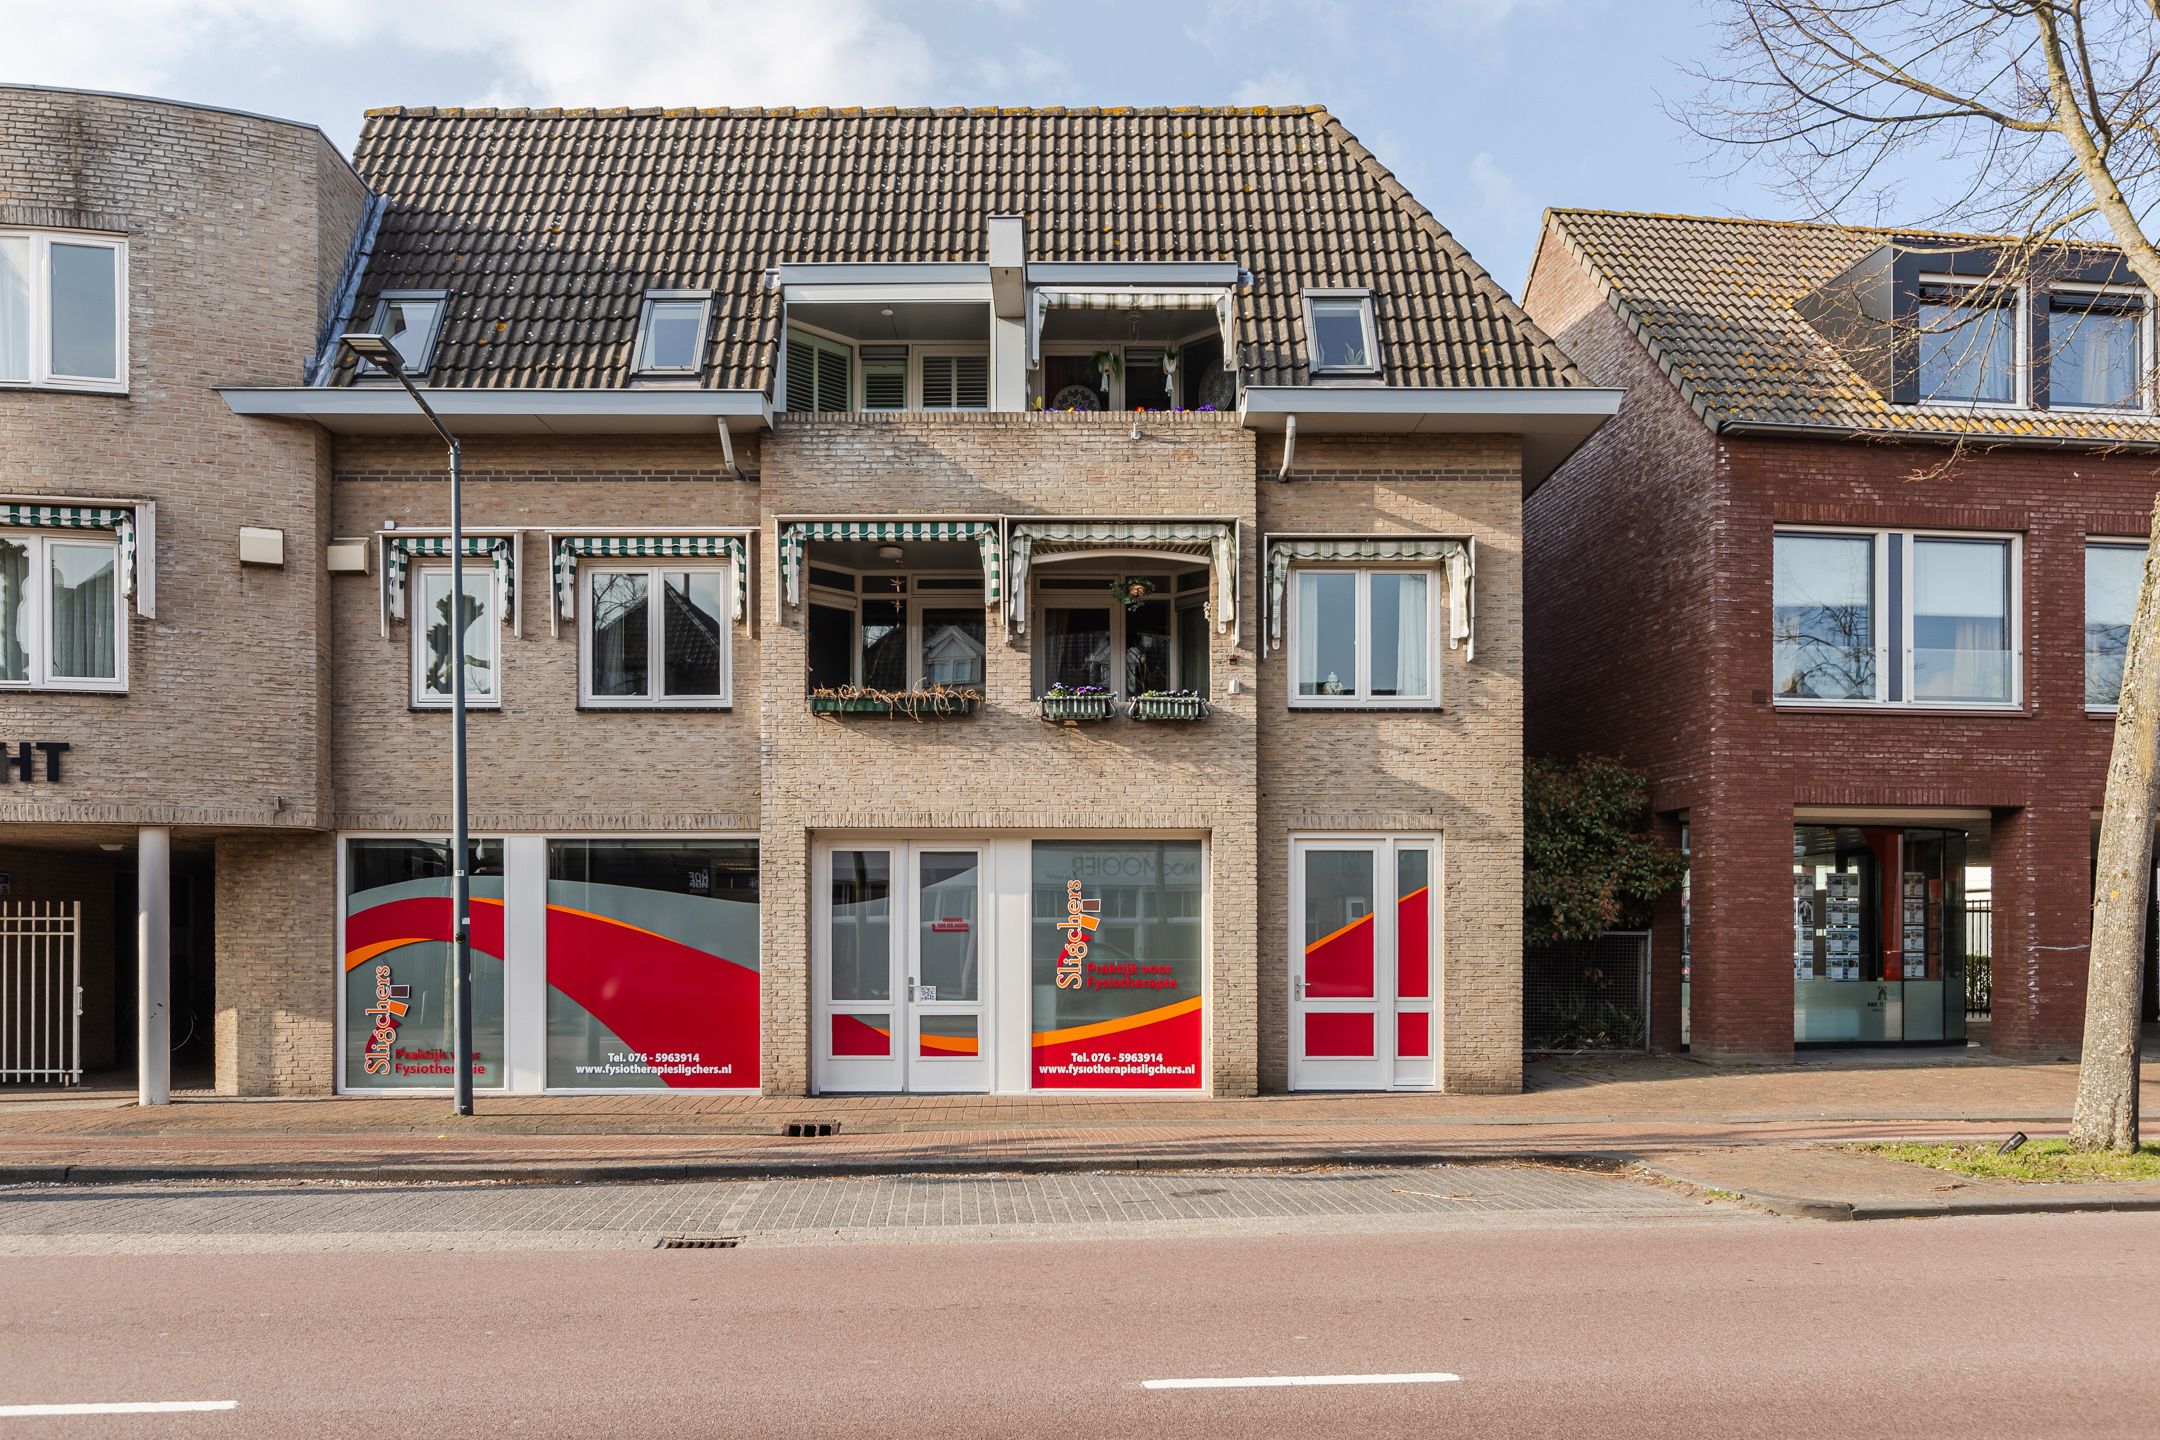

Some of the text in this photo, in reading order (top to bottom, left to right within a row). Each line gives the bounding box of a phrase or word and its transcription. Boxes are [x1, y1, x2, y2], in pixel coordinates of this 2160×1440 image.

[1056, 879, 1088, 989] Sligchers
[1087, 962, 1172, 976] Praktijk voor
[1087, 976, 1177, 991] Fysiotherapie
[364, 965, 397, 1075] Sligchers
[395, 1049, 481, 1063] Praktijk vr
[608, 1053, 626, 1063] Tel.
[628, 1053, 647, 1063] 076
[655, 1053, 700, 1063] 5963914
[1071, 1053, 1089, 1063] Tel.
[1091, 1053, 1111, 1063] 076
[1118, 1053, 1163, 1063] 5963914
[395, 1063, 486, 1077] Fysiotherie
[576, 1064, 732, 1076] www.fysiotherapiesligchers.nl
[1039, 1064, 1195, 1076] www.fysiotherapiesligchers.nl
